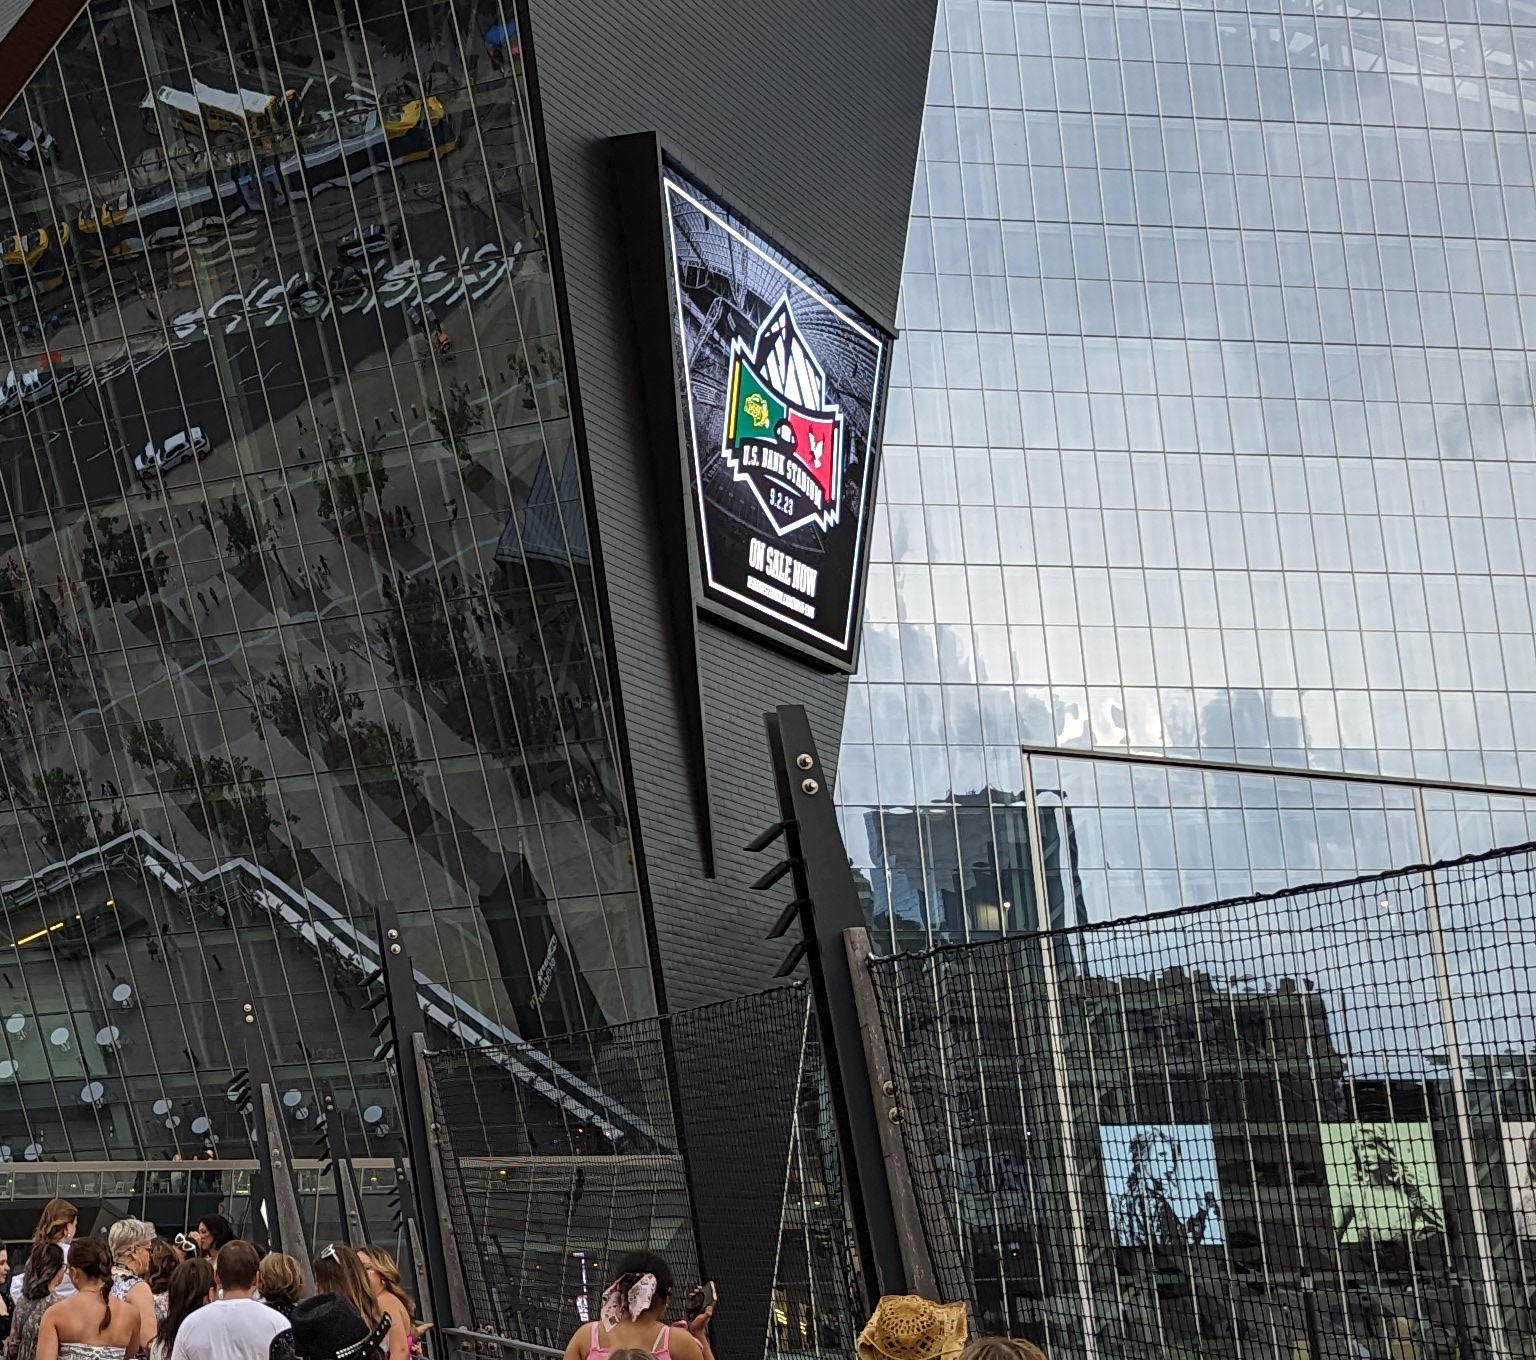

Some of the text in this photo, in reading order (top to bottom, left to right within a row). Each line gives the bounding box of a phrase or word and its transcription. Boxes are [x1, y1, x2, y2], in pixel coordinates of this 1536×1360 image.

[743, 445, 822, 510] U.S. BANK STADIUM
[769, 488, 793, 516] 9.2.23
[749, 537, 766, 571] ON
[765, 546, 792, 585] SALE
[791, 559, 818, 597] NOW
